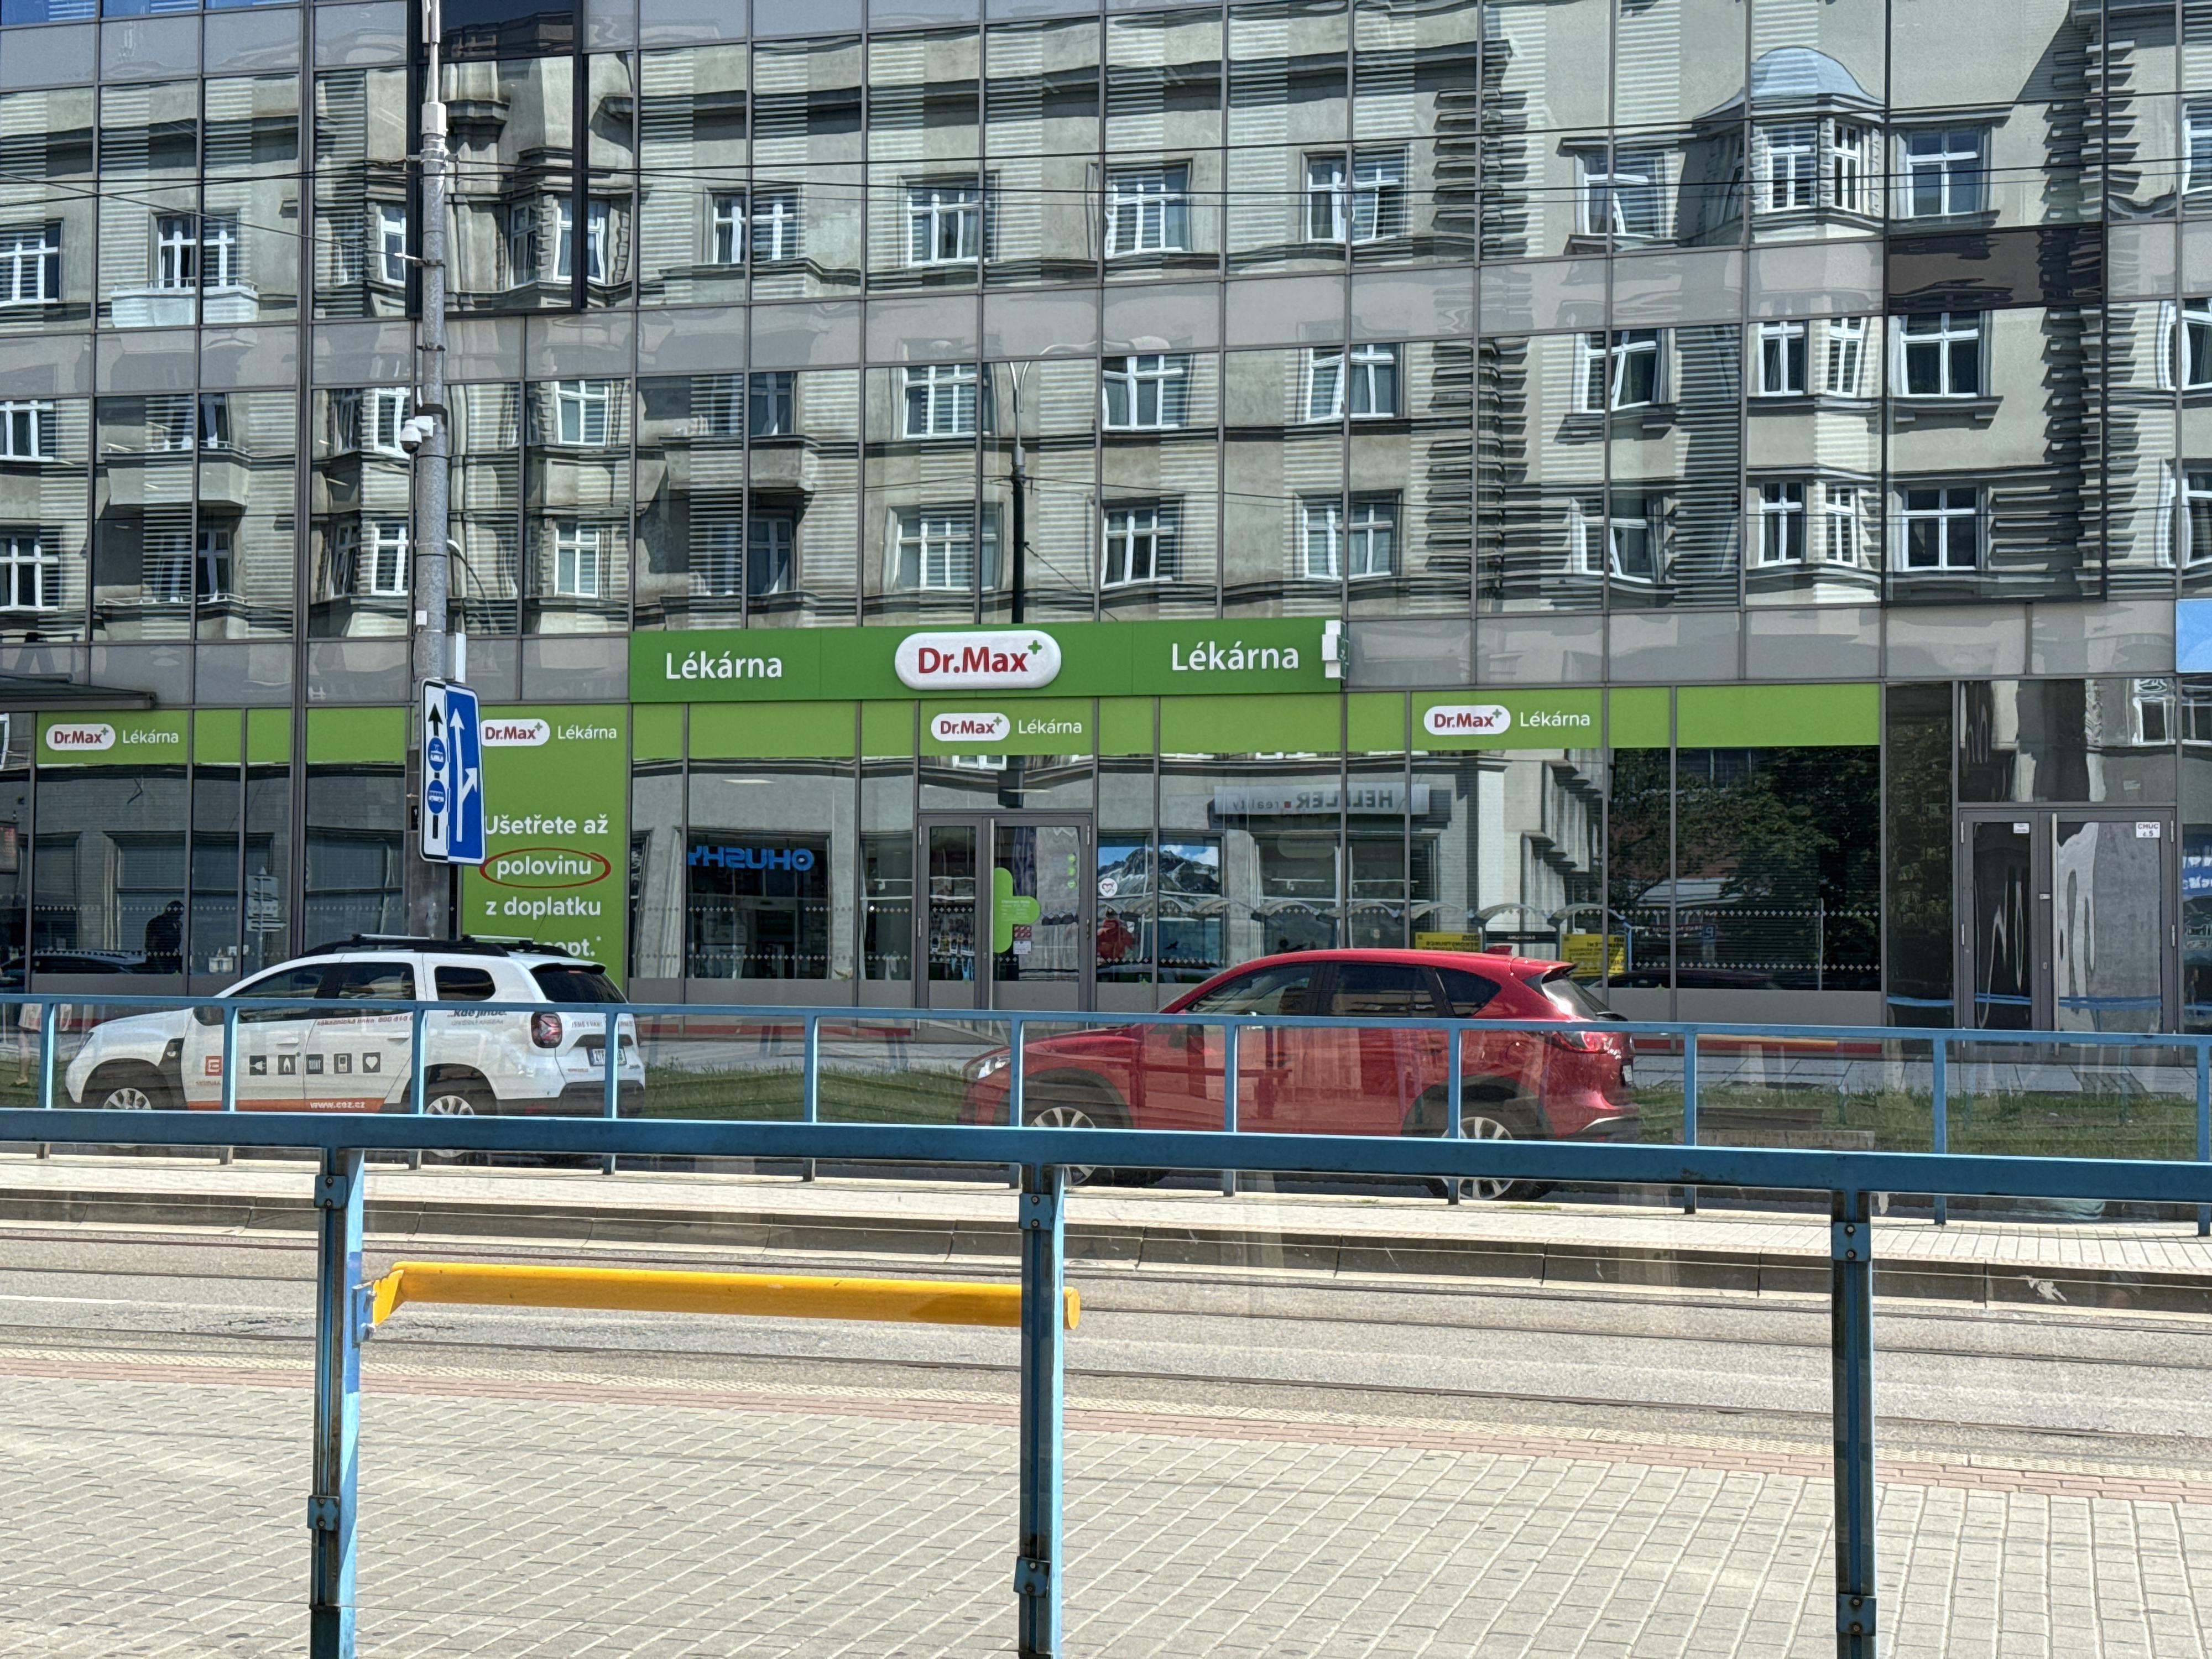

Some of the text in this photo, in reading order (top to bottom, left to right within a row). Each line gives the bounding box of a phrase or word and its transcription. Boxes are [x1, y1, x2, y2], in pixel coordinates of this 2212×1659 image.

[665, 650, 782, 680] Lékárna
[919, 646, 1029, 674] Dr.Max
[1172, 640, 1299, 672] Lékárna
[940, 719, 1082, 735] Dr.Max Lékárna
[1434, 711, 1590, 728] Dr.Max Lékárna
[54, 729, 179, 744] Dr.Max Lékárna
[557, 724, 617, 740] Lékárna
[486, 813, 608, 834] Ušetřete až
[497, 854, 591, 880] polovinu
[486, 896, 601, 921] z doplatku
